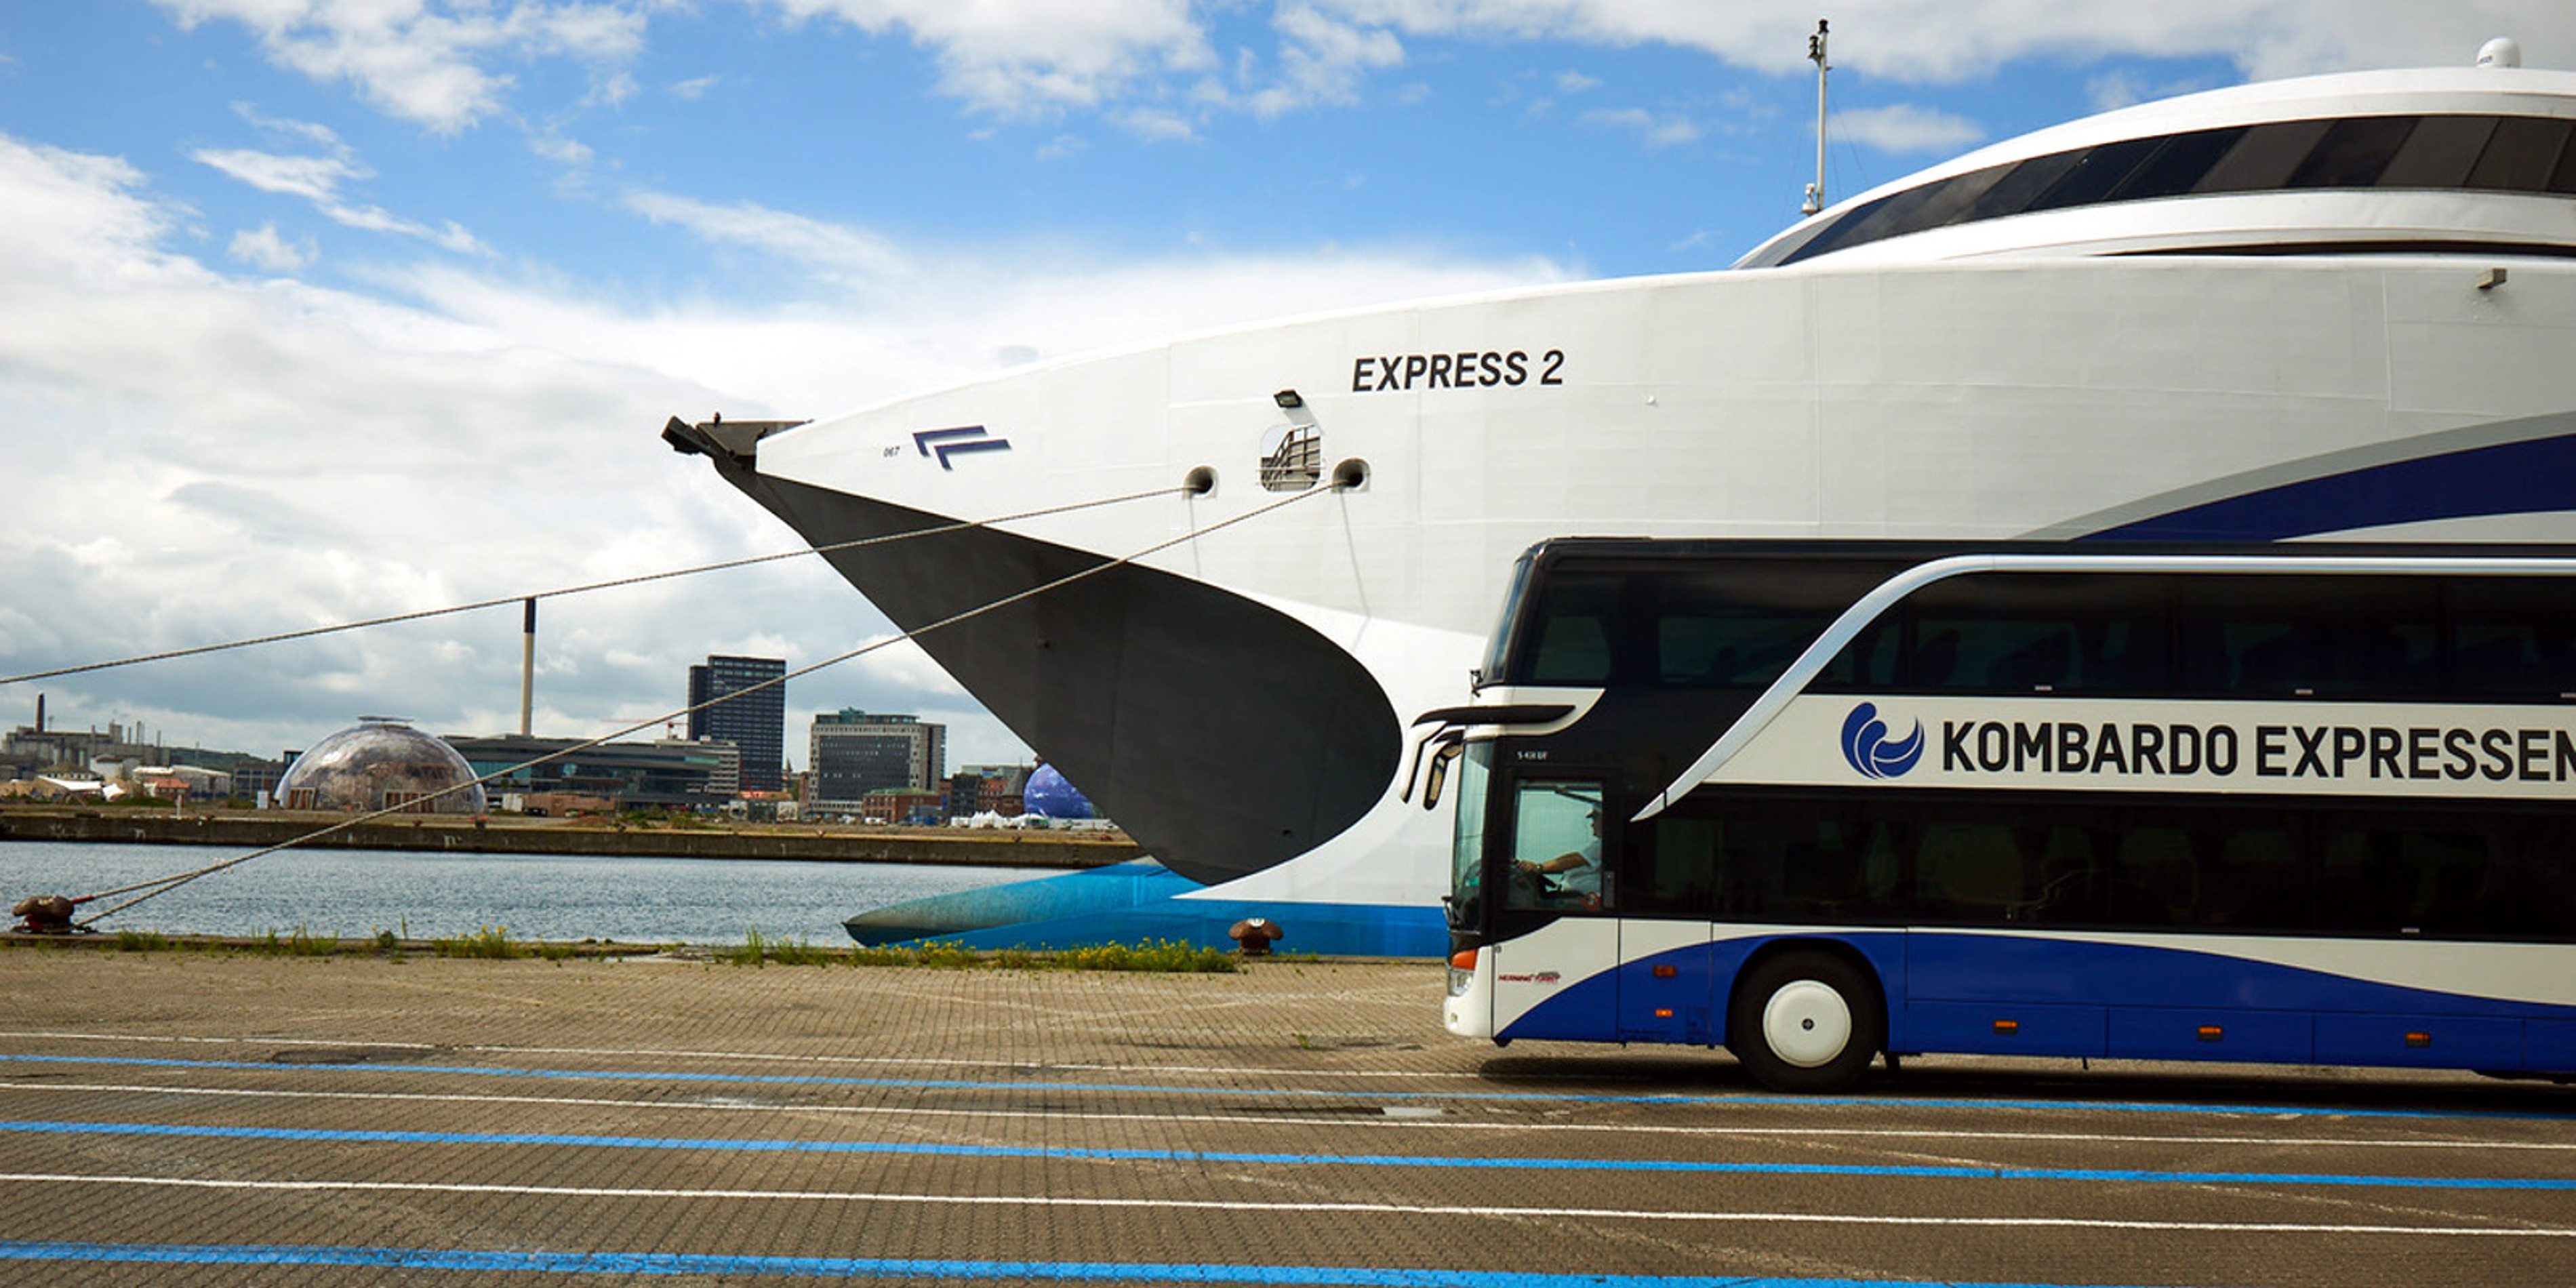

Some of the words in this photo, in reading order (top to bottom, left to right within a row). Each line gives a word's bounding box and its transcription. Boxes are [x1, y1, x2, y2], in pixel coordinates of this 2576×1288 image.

[1352, 351, 1529, 392] EXPRESS
[1540, 349, 1565, 385] 2
[1943, 721, 2238, 776] KOMBARDO
